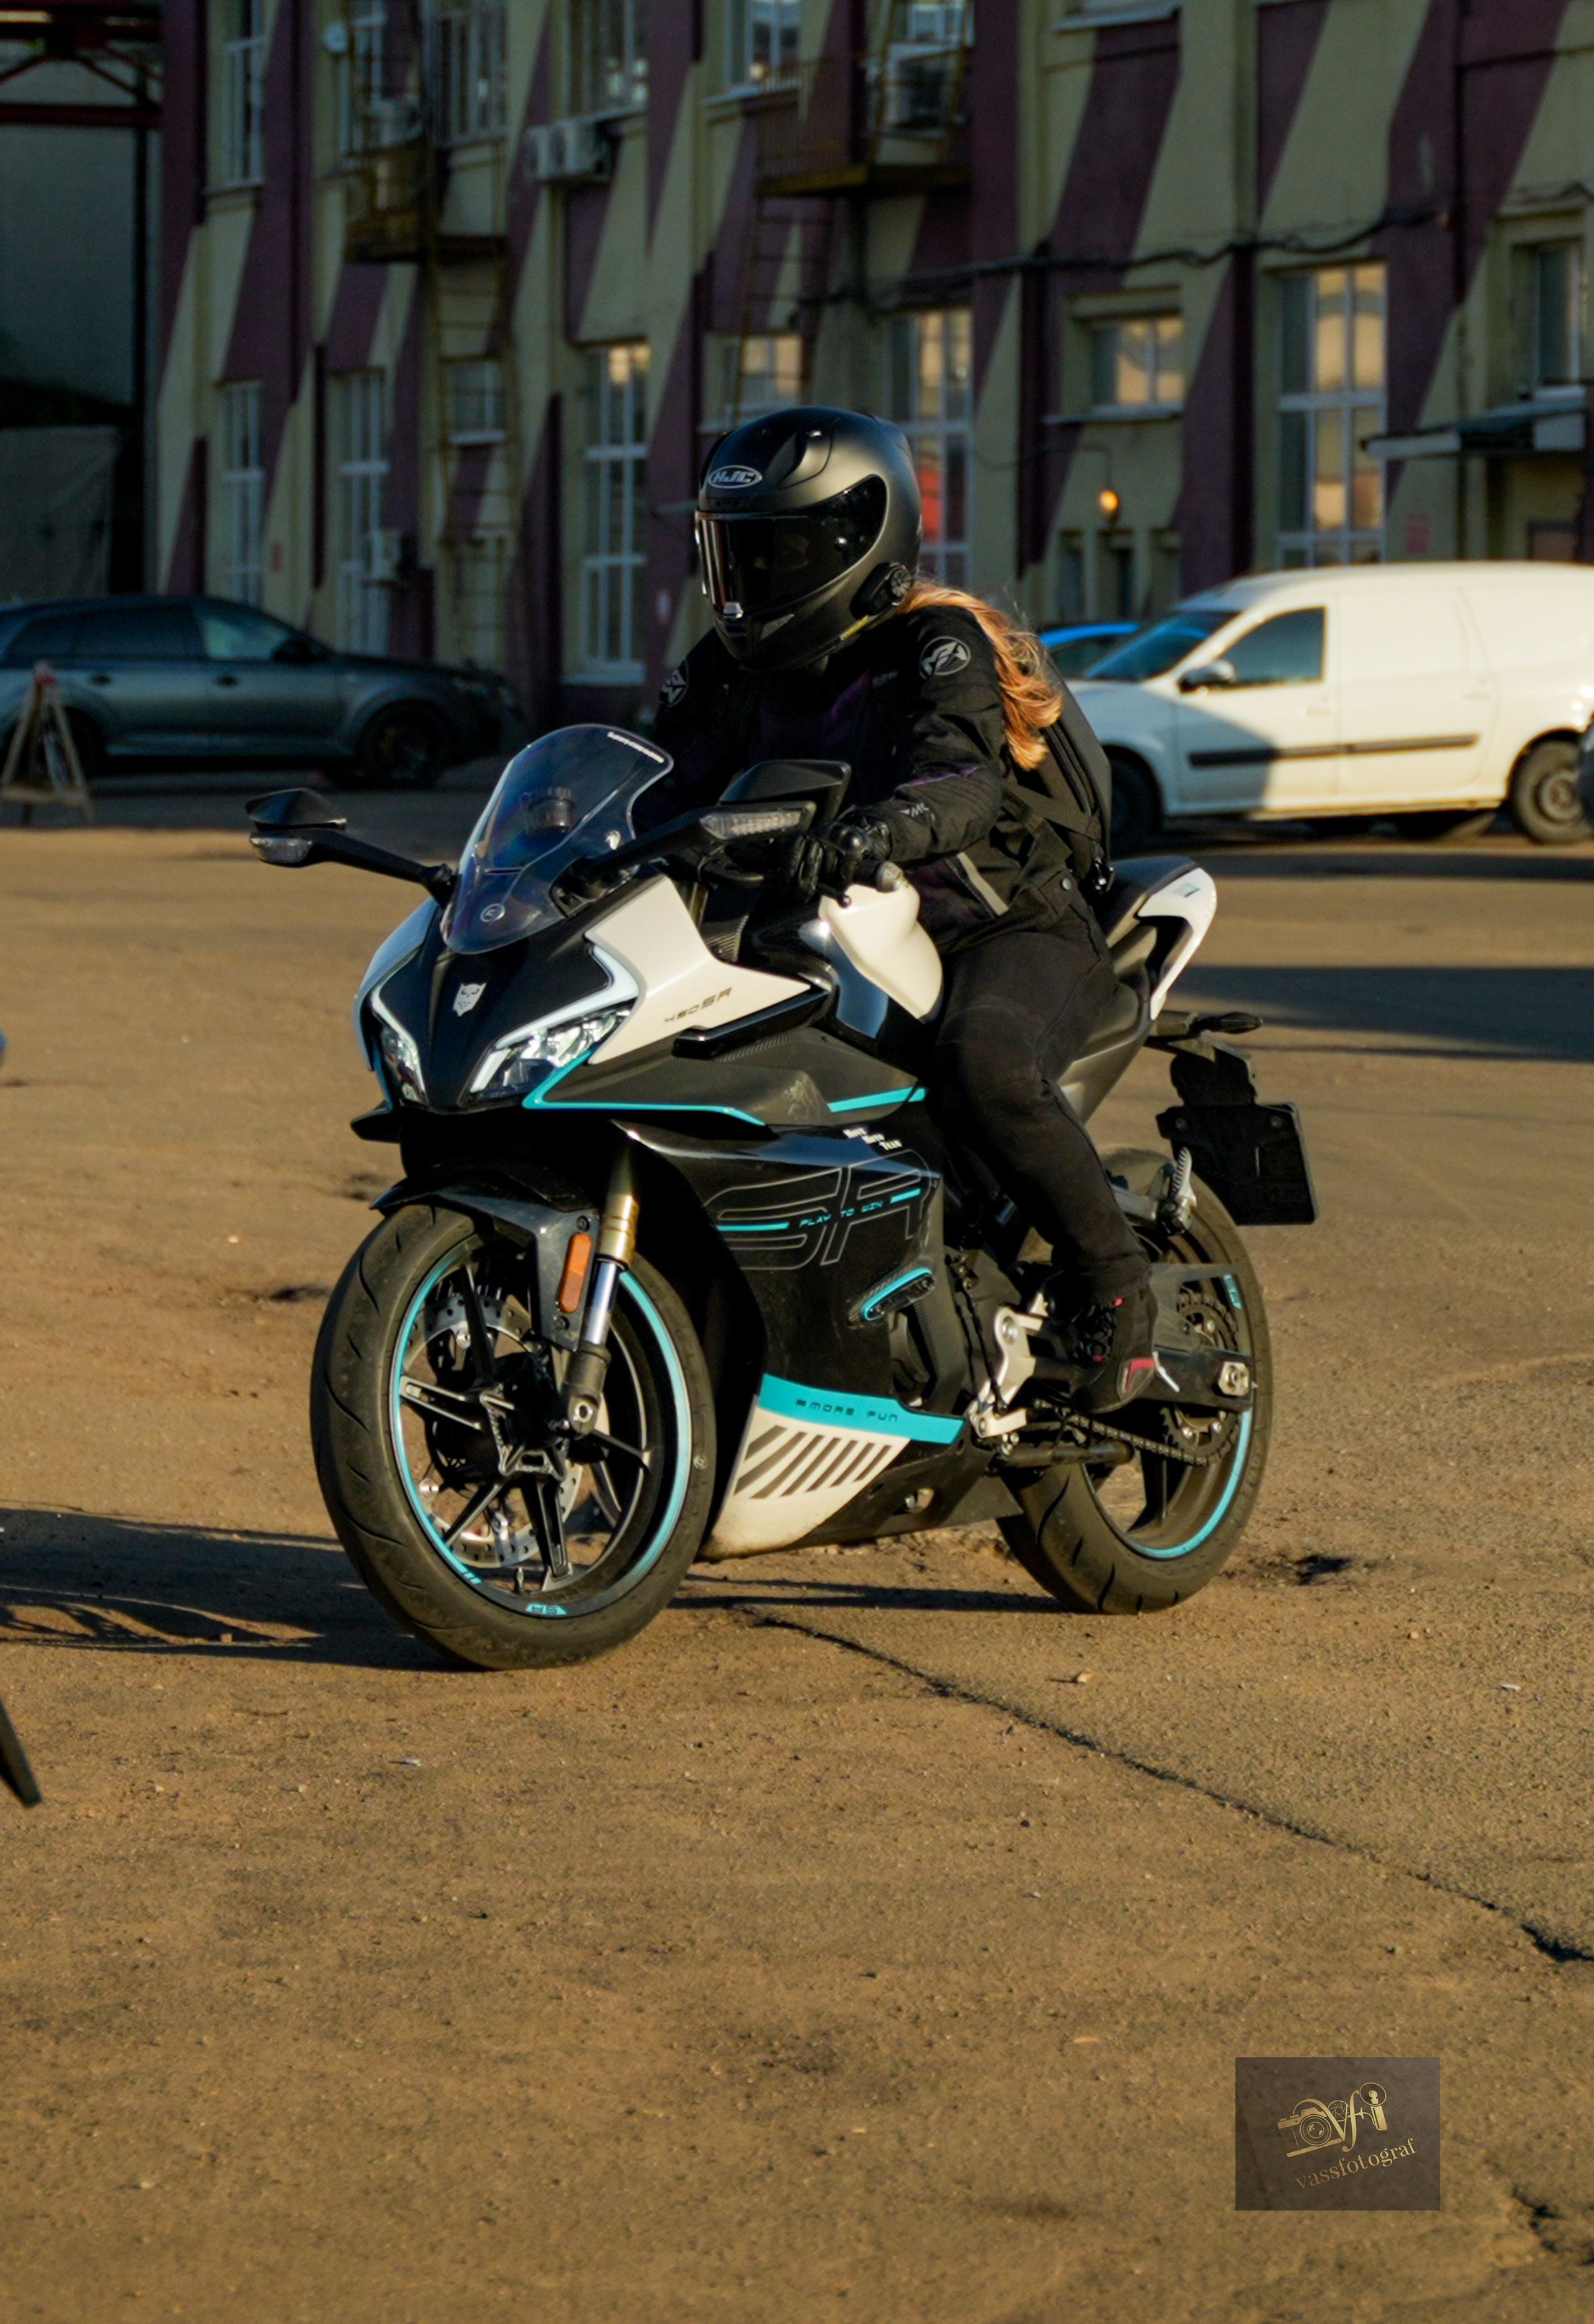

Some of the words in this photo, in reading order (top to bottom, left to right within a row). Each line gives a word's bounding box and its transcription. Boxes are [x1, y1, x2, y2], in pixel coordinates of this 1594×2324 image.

[712, 471, 755, 483] HJC
[799, 1214, 832, 1228] PLAY
[841, 1208, 855, 1218] TO
